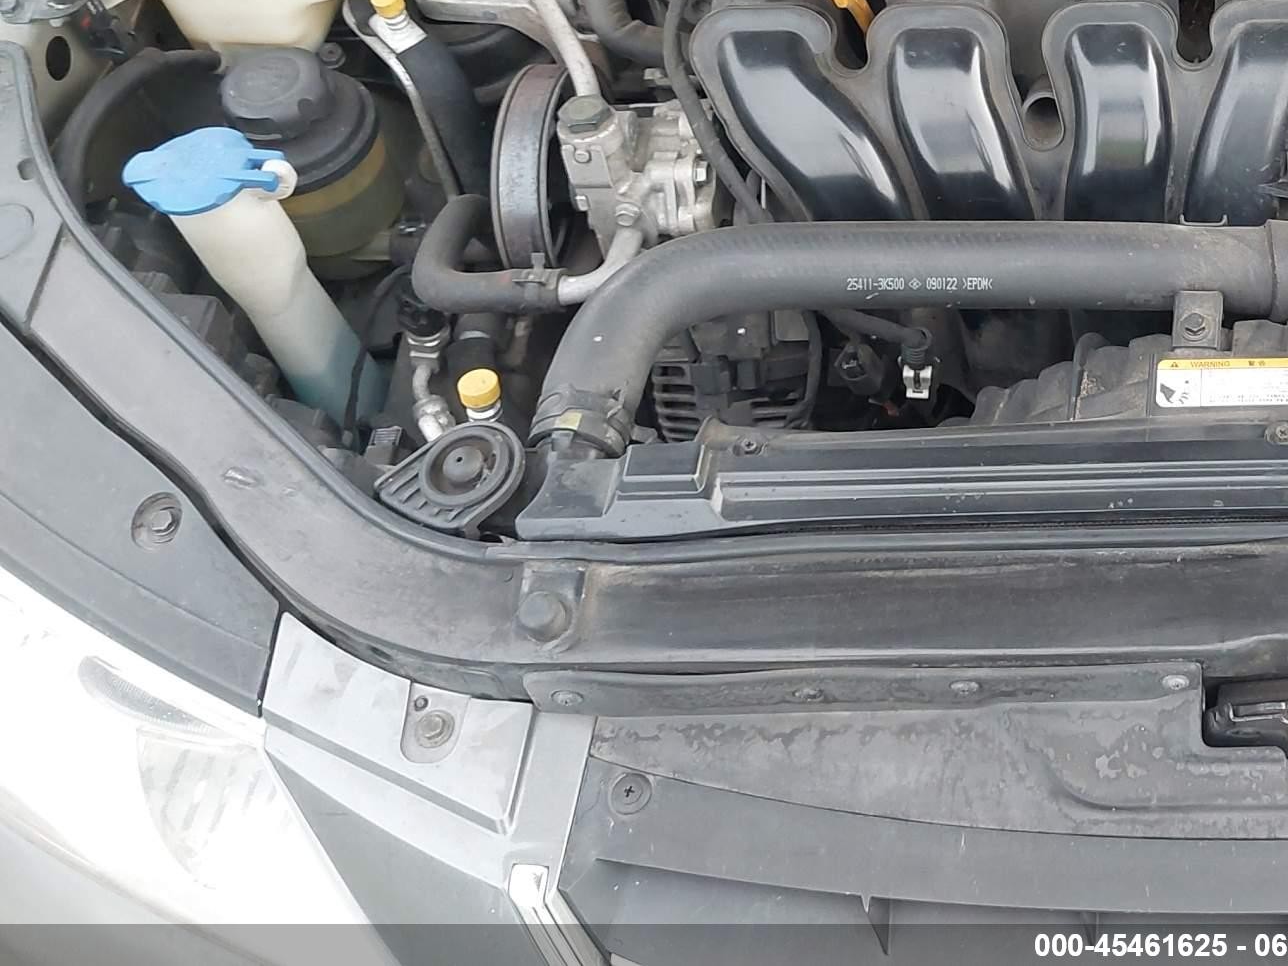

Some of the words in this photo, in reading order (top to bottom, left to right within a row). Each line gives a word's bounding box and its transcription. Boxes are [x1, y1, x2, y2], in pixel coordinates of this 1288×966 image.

[846, 277, 905, 291] 25411-3K500
[926, 277, 958, 291] 090122
[1189, 360, 1232, 369] WARNING
